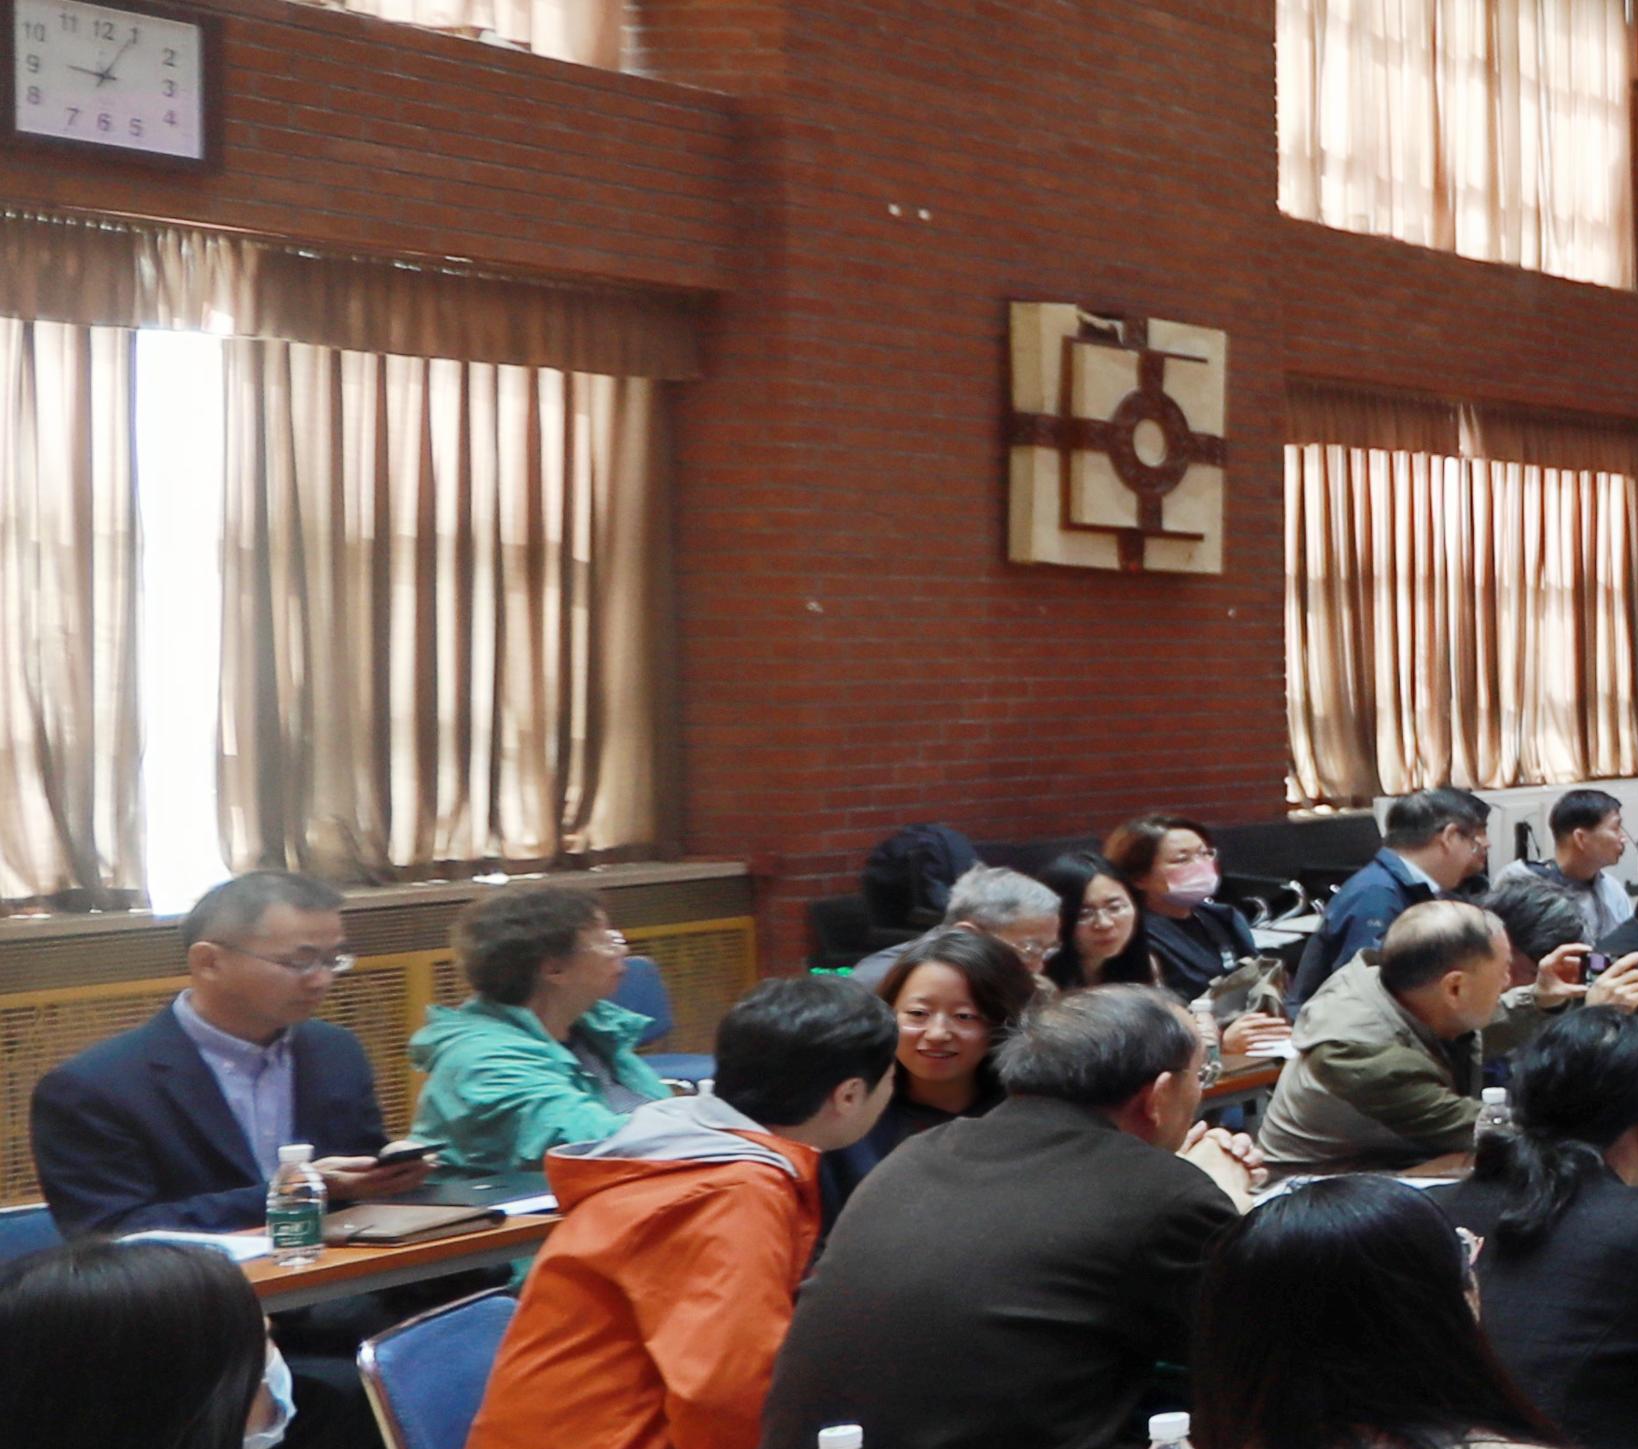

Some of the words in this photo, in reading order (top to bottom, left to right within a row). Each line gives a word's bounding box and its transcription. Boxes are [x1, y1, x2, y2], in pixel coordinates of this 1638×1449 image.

[24, 21, 46, 42] 10
[59, 12, 79, 33] 11
[93, 20, 115, 41] 12
[129, 27, 139, 44] 1
[26, 54, 41, 74] 9
[162, 48, 177, 67] 2
[27, 85, 41, 105] 8
[162, 79, 177, 98] 3
[66, 107, 81, 127] 7
[97, 113, 112, 132] 6
[128, 117, 144, 137] 5
[162, 109, 177, 127] 4
